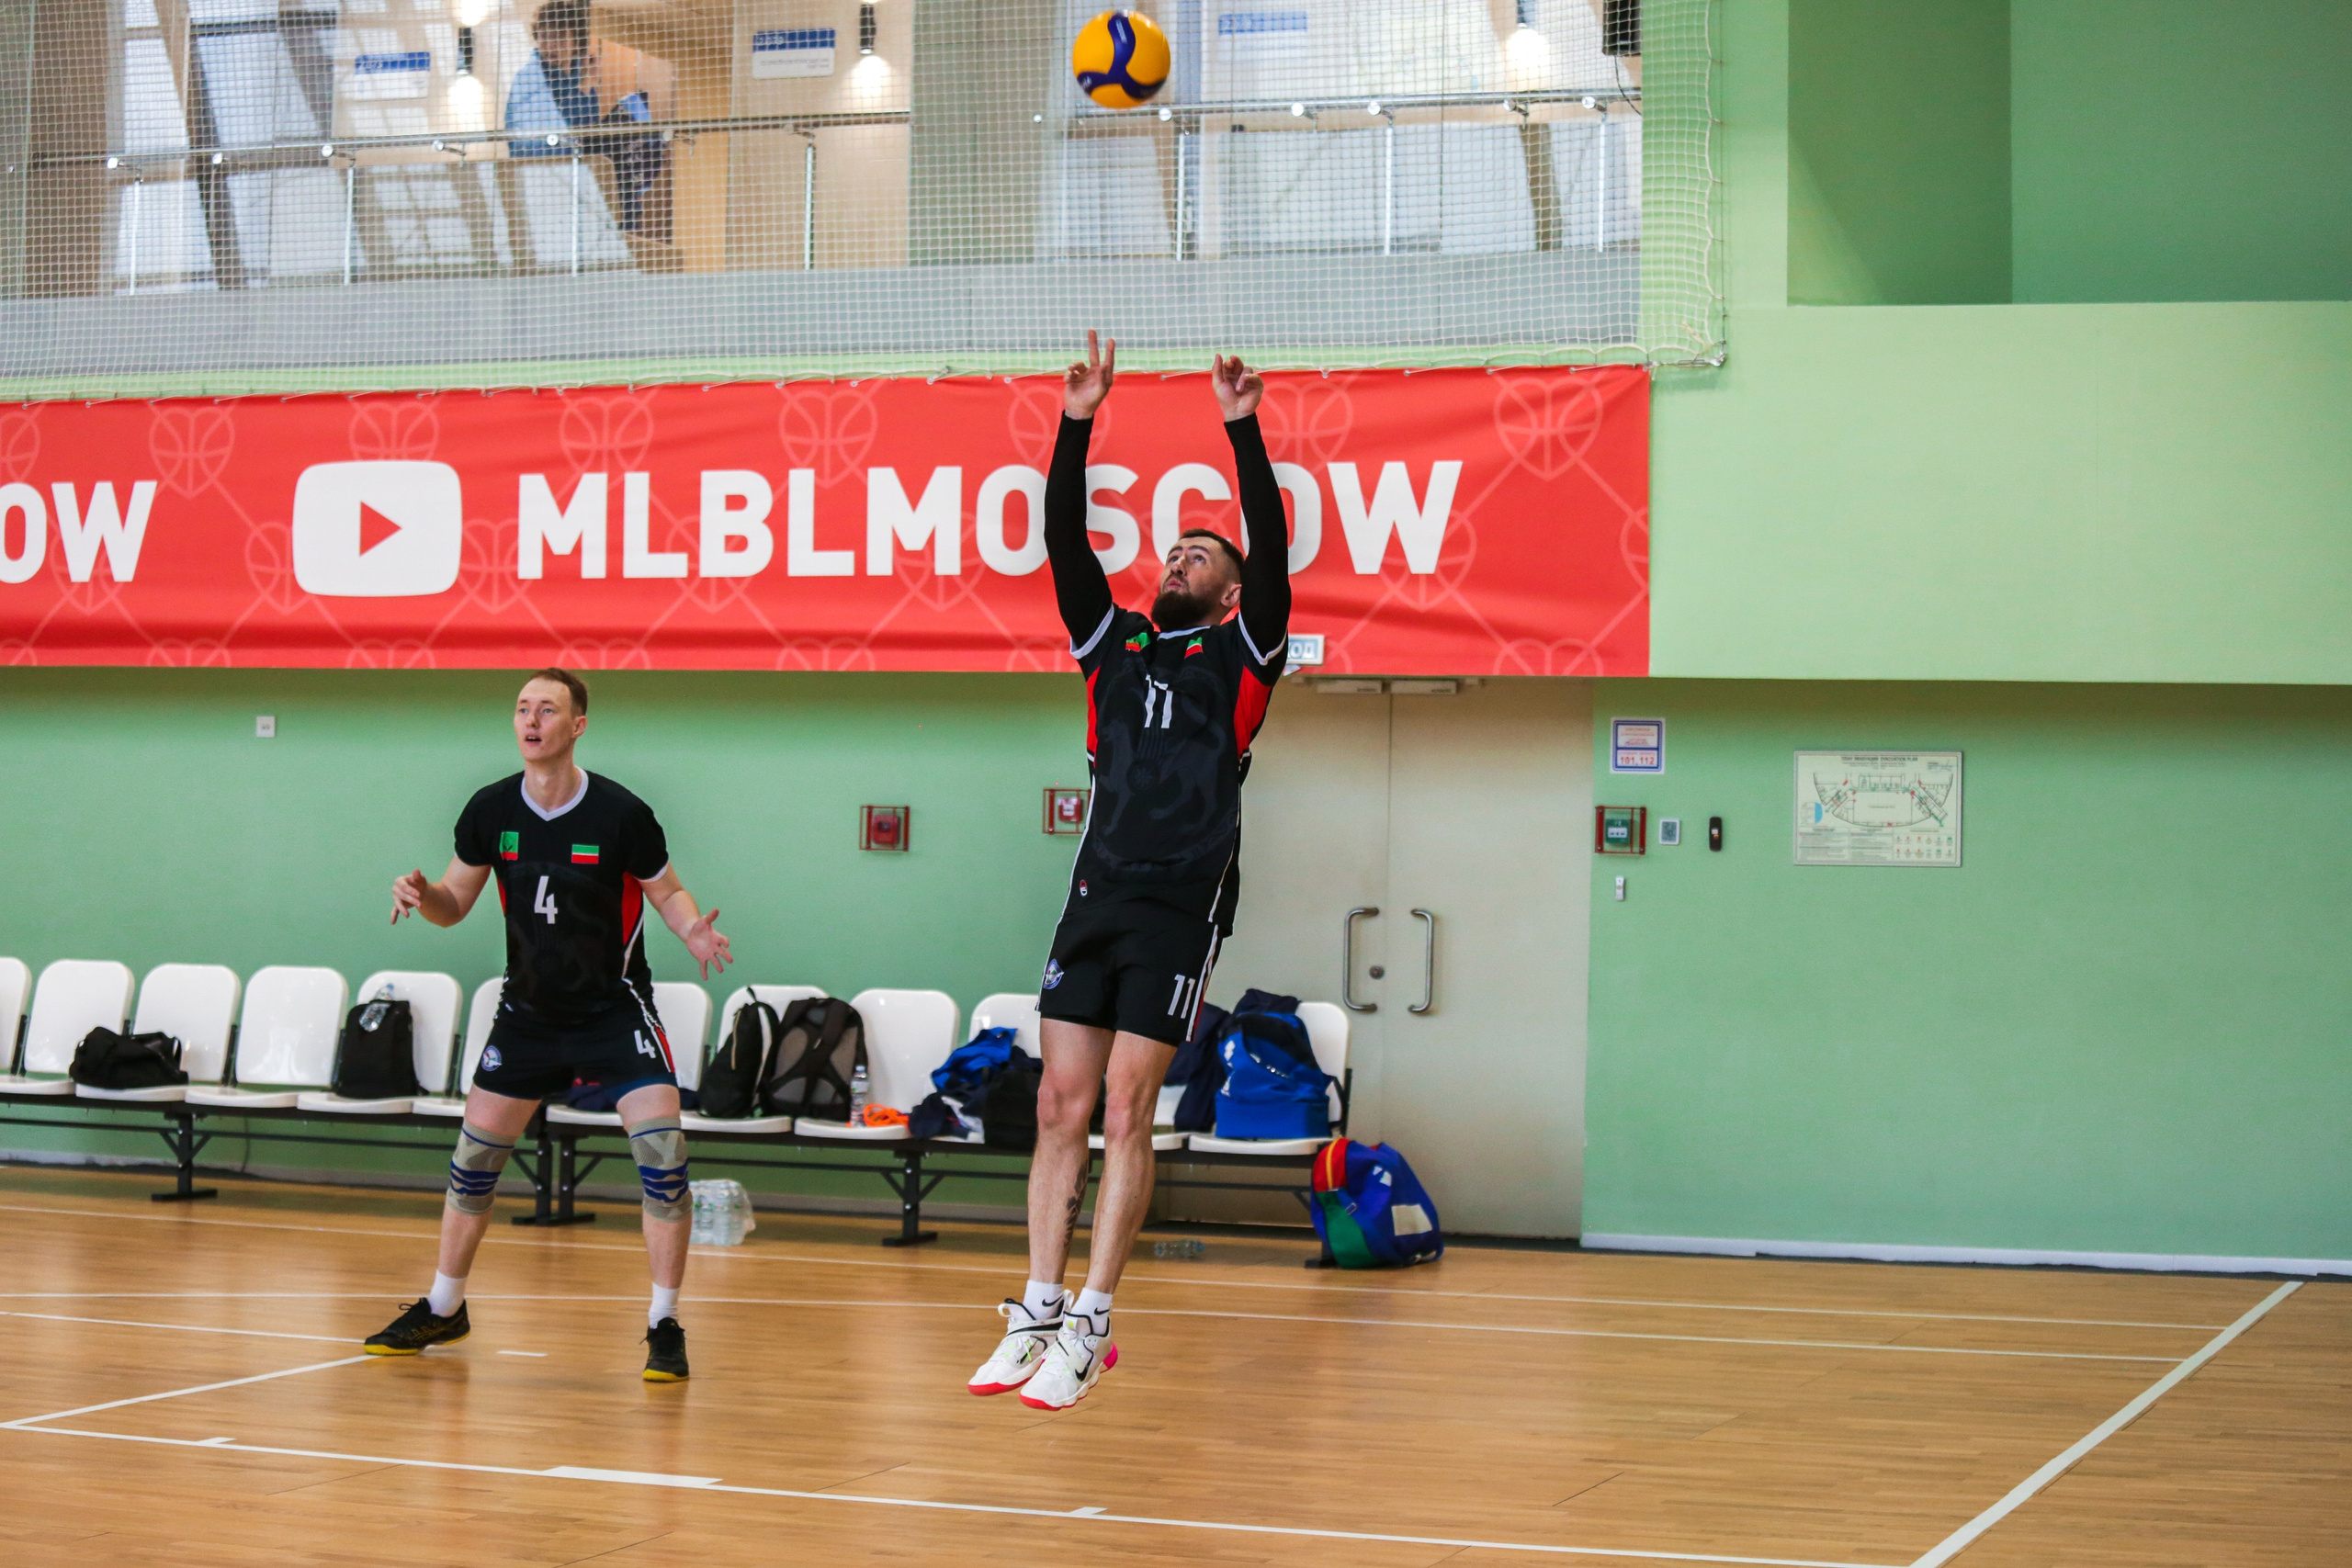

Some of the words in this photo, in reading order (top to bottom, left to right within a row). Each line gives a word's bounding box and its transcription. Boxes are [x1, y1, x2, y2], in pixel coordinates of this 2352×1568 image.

[1145, 675, 1174, 729] 11
[535, 875, 559, 924] 4
[1168, 974, 1196, 1020] 11
[634, 1030, 656, 1059] 4
